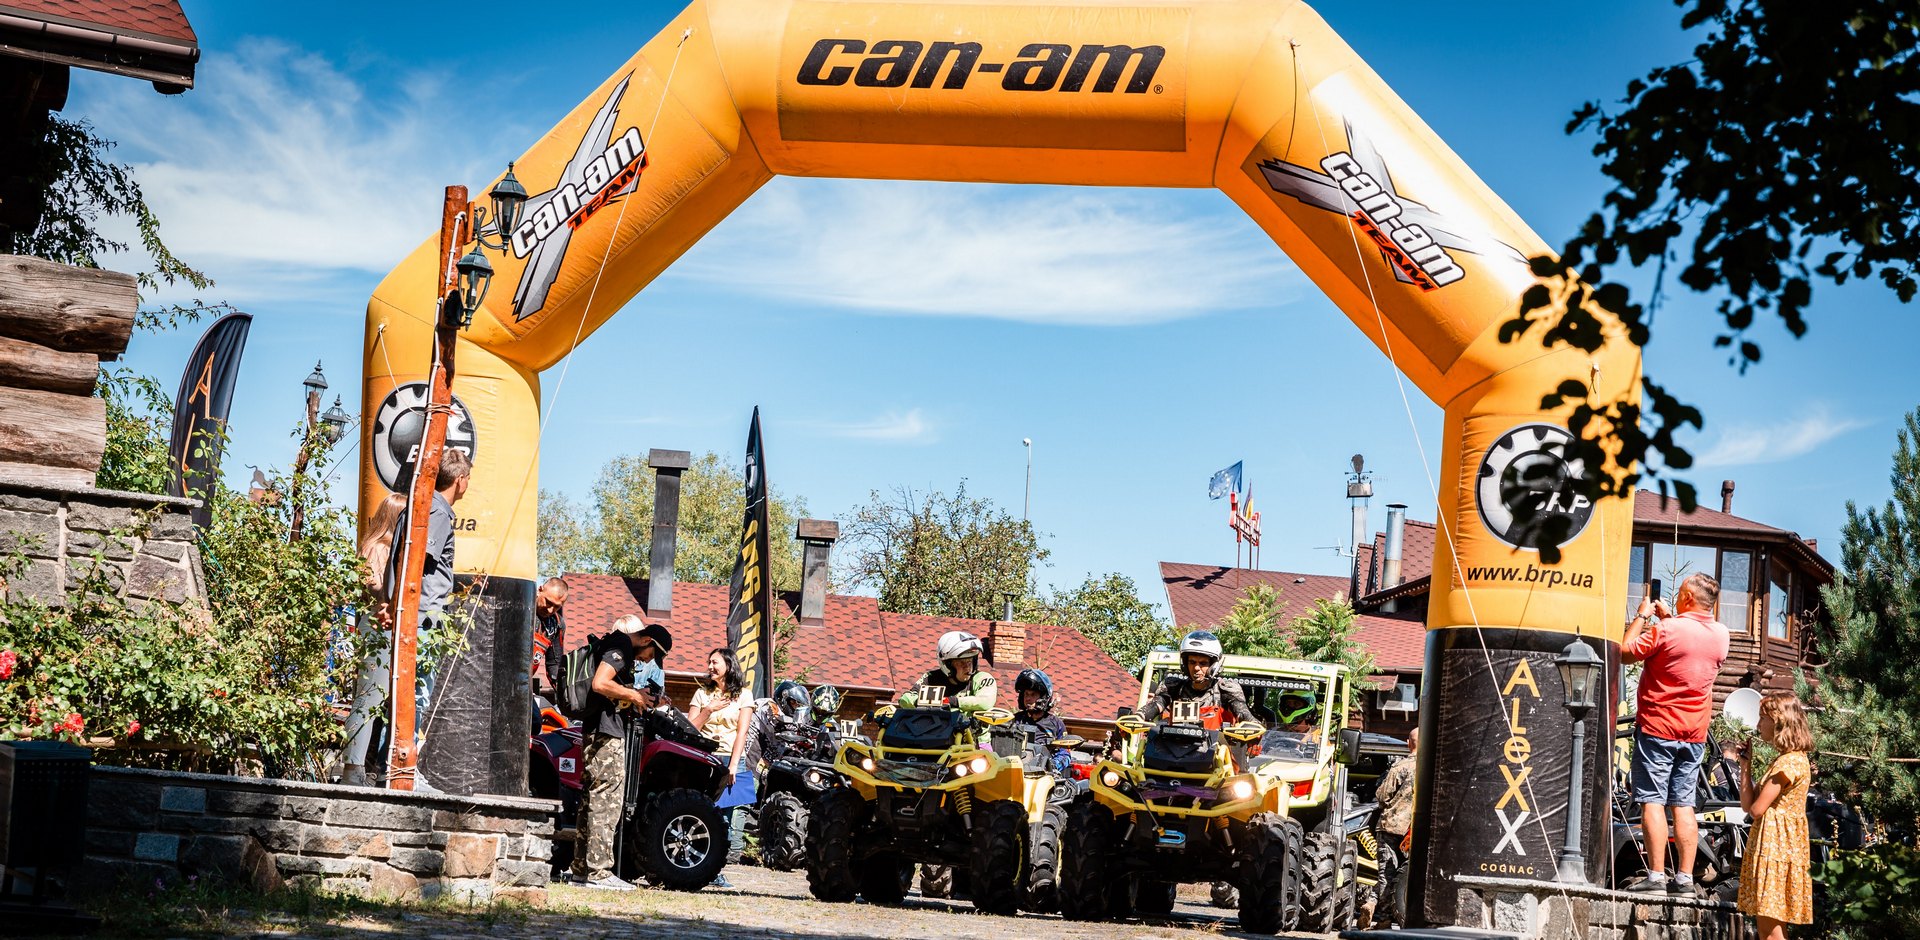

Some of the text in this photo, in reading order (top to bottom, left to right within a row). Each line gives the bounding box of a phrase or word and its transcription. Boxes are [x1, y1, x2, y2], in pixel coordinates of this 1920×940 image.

[511, 126, 645, 259] can-am
[568, 152, 648, 229] TEAM
[1320, 151, 1466, 288] can-am
[1355, 211, 1435, 291] TEAM
[1467, 564, 1594, 588] www.brp.ua
[919, 686, 942, 705] 11
[1173, 702, 1199, 721] 11
[841, 720, 857, 738] 17
[1480, 863, 1534, 875] COGNAC
